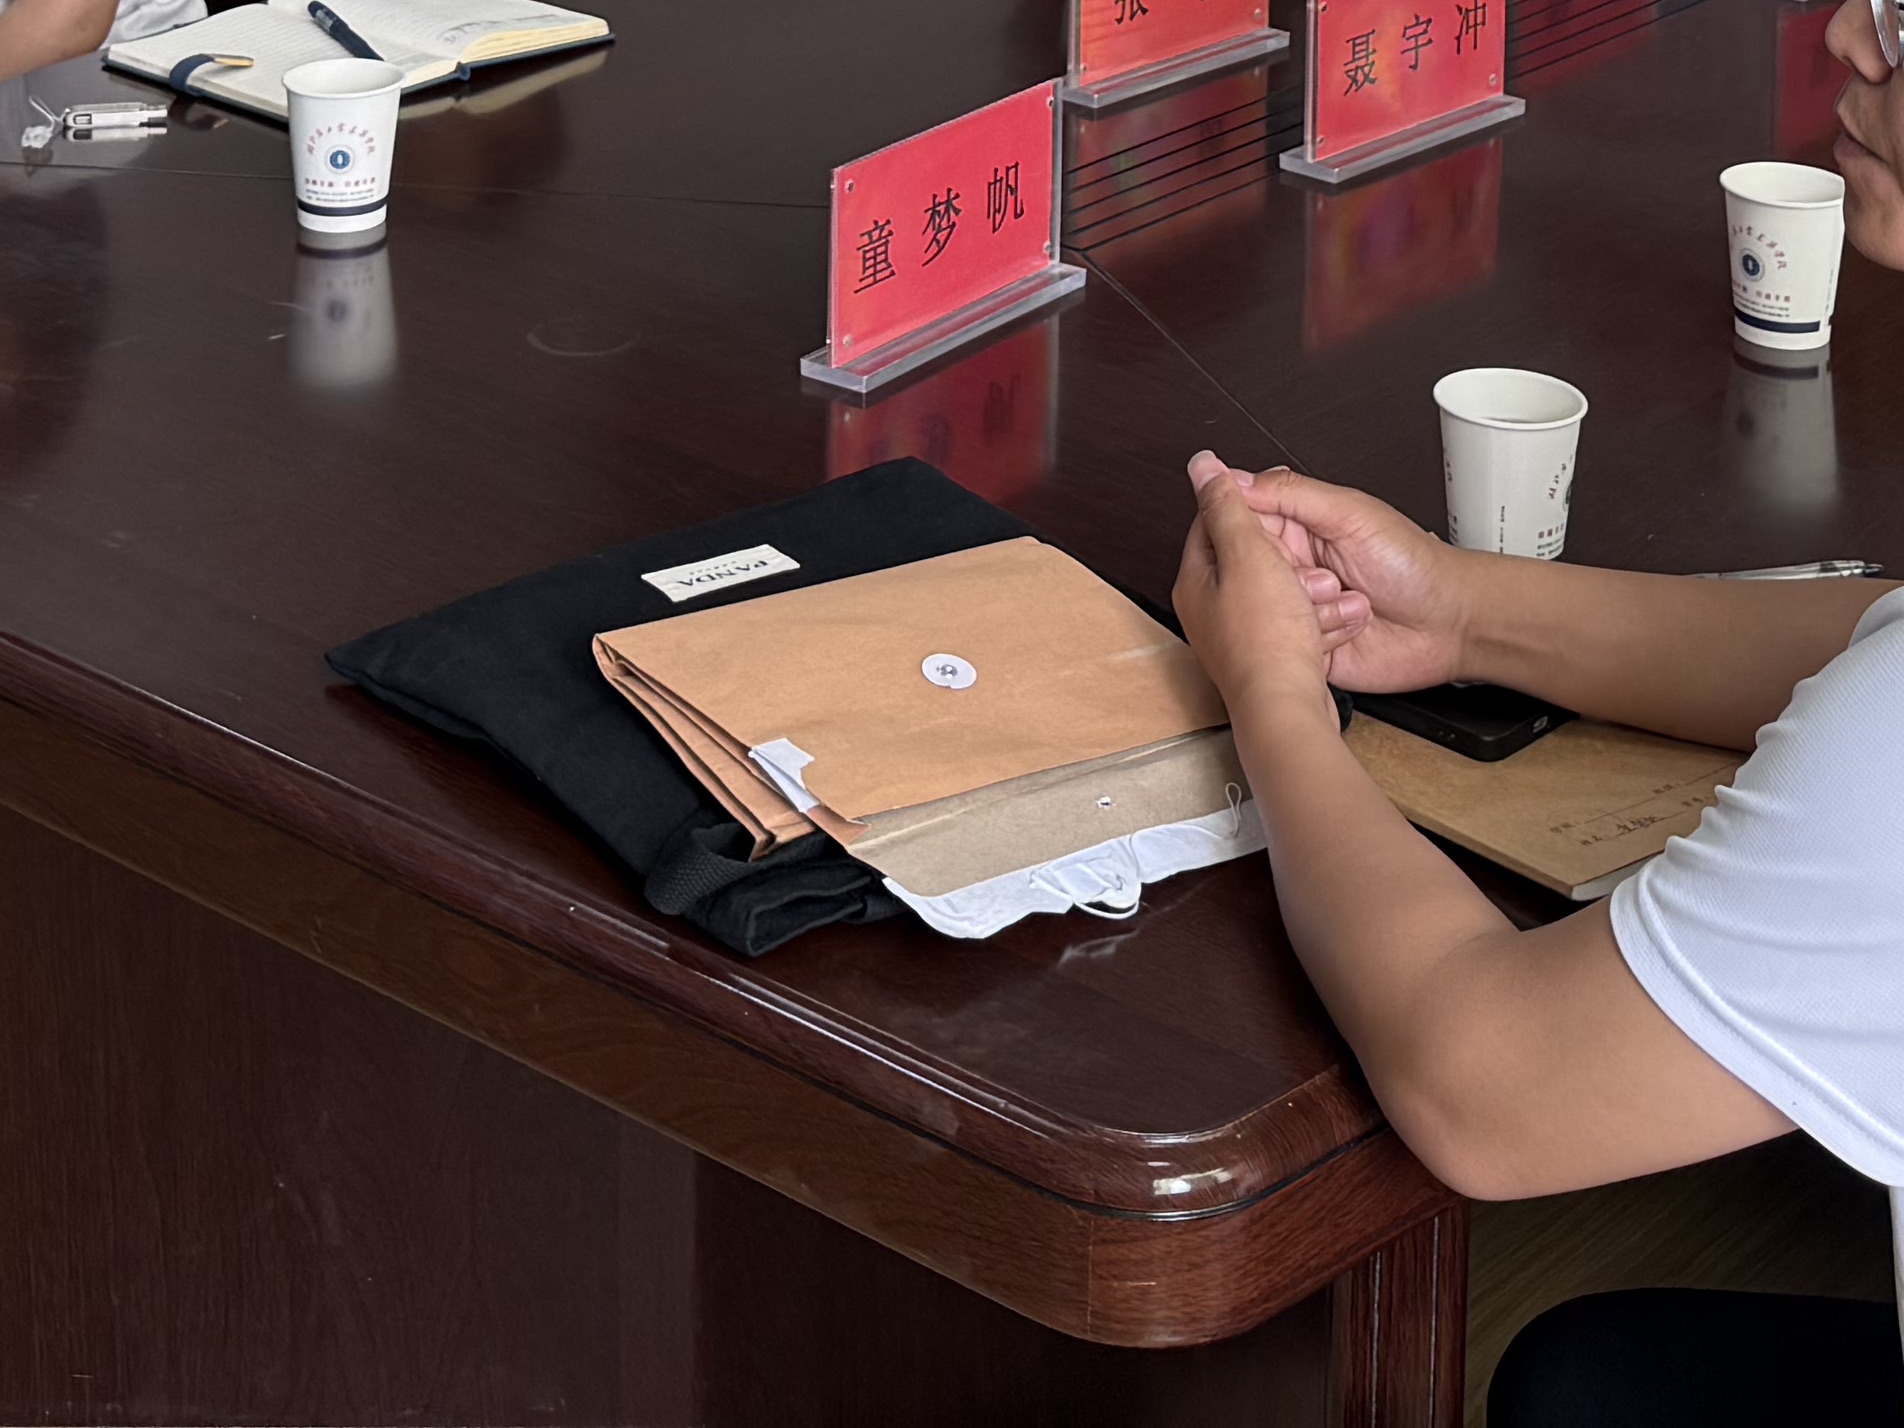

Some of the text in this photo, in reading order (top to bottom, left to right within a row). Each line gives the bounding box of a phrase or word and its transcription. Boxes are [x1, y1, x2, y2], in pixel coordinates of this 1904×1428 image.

[853, 161, 1025, 294] 童梦帆
[677, 560, 769, 587] PANDA
